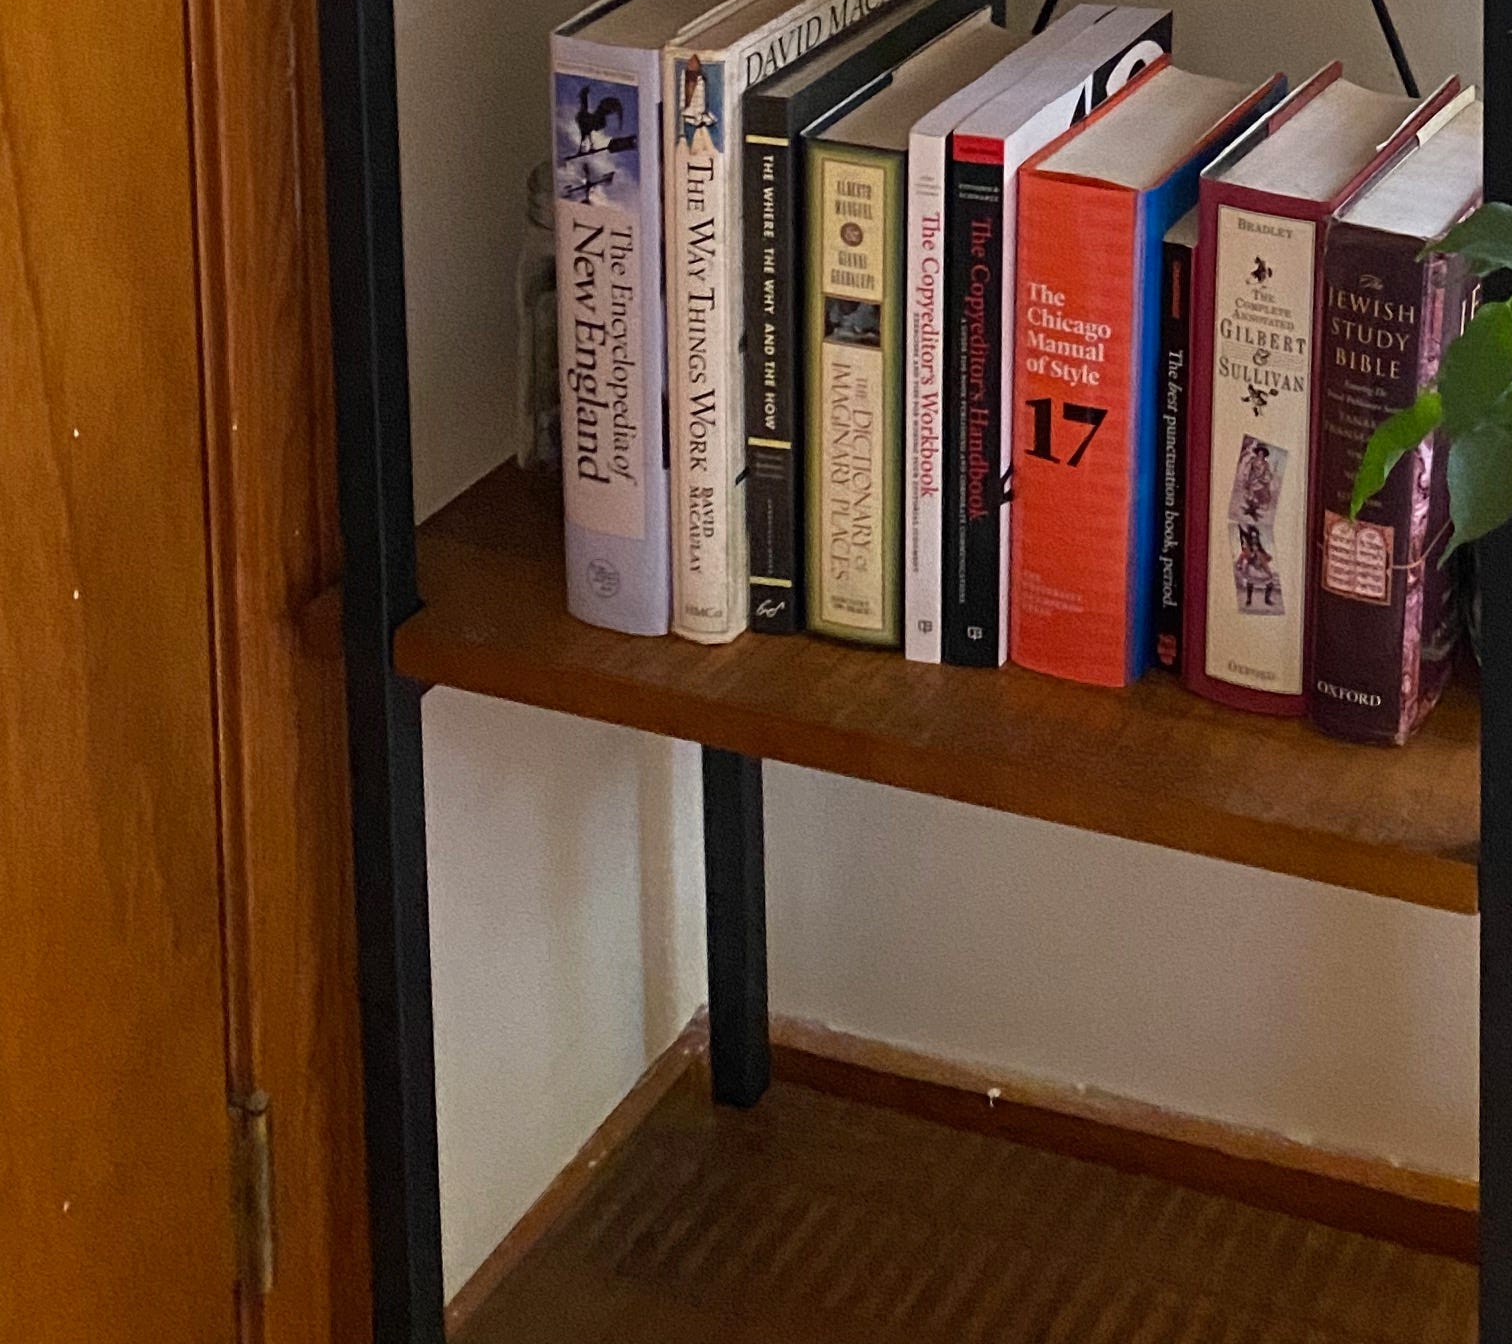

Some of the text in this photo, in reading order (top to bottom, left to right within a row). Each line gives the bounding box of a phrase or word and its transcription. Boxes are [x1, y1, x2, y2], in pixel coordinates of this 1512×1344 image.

[745, 14, 823, 87] DAVID
[763, 155, 774, 181] THE
[922, 212, 941, 251] The
[970, 218, 992, 257] The
[1237, 216, 1294, 240] BRADLEY
[763, 248, 775, 274] THE
[1027, 281, 1066, 307] The
[1234, 296, 1293, 319] COMPLETE
[1251, 287, 1276, 304] THE
[1328, 285, 1415, 325] JEWISH
[686, 157, 716, 473] THE WAY THINGS WORK
[916, 257, 940, 385] Copyeditor's
[965, 264, 991, 400] Copyeditor's
[1027, 306, 1112, 342] Chicago
[1232, 308, 1295, 332] ANNOTATED
[1331, 316, 1410, 352] STUDY
[566, 218, 611, 485] New England
[764, 323, 775, 356] AND
[1026, 330, 1105, 363] Manual
[1219, 317, 1307, 355] GILBERT
[607, 225, 638, 487] The Encyclopedia of
[764, 361, 776, 388] THE
[1026, 355, 1101, 388] of Style
[1218, 354, 1306, 394] SULLIVAN
[1252, 347, 1272, 367] &
[1335, 346, 1402, 380] BIBLE
[765, 397, 777, 430] HOW
[831, 361, 852, 490] IMAGINARY
[1024, 397, 1109, 469] 17
[920, 391, 939, 498] Workbook
[968, 407, 989, 521] Handbook
[852, 409, 873, 550] DICTIONARY
[1159, 348, 1184, 609] The best punctuation book, period.
[688, 485, 703, 574] MACAULAY
[702, 486, 715, 539] DAVID
[831, 497, 851, 581] PLACES
[1316, 680, 1382, 707] OXFORD
